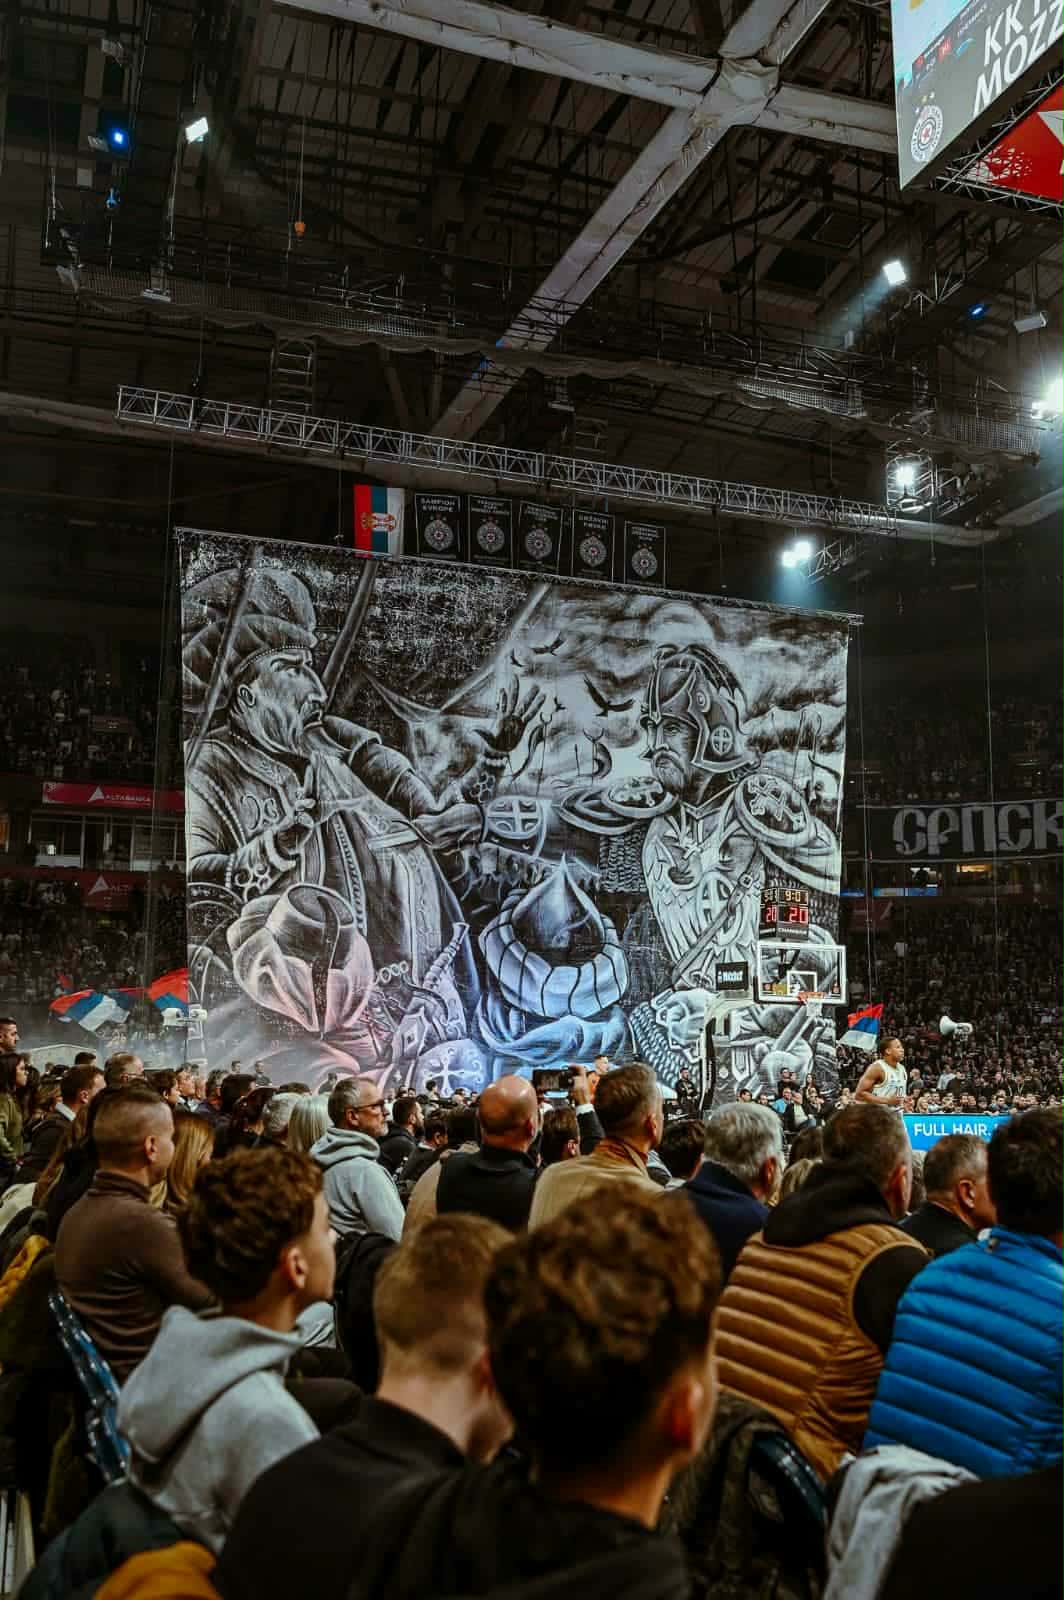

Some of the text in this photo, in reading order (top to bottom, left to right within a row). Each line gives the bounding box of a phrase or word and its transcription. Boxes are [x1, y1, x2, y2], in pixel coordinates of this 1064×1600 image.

[984, 0, 1023, 67] KK
[789, 907, 809, 923] 20
[914, 1123, 992, 1137] FULL HAIR.
